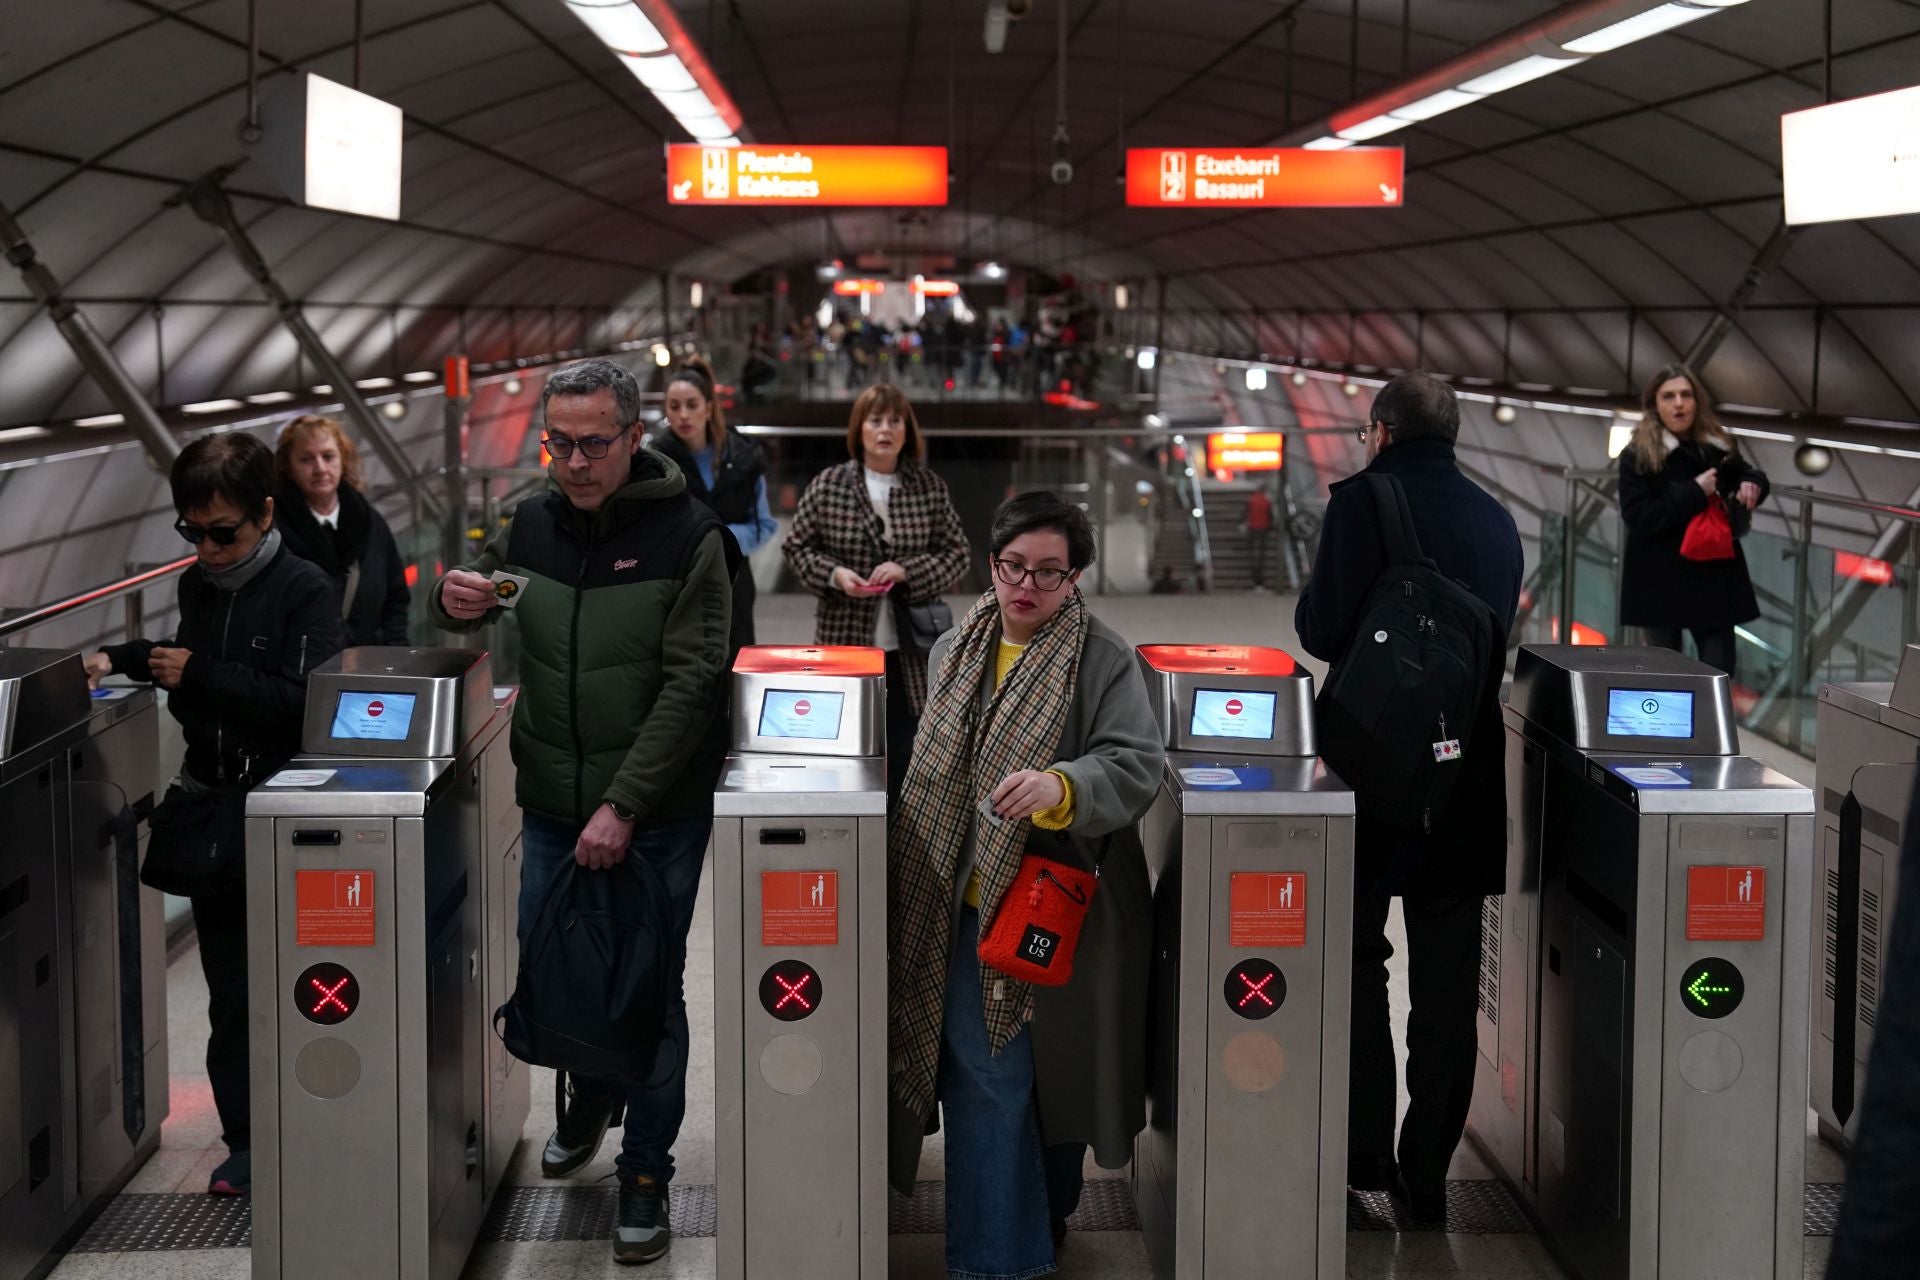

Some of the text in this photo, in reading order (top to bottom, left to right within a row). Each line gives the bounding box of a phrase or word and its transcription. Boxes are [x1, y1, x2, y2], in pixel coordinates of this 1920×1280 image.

[1169, 154, 1280, 175] 1 Etxebarri
[1166, 178, 1265, 199] 2 Basauri
[1032, 933, 1051, 948] TO
[1028, 944, 1047, 958] US
